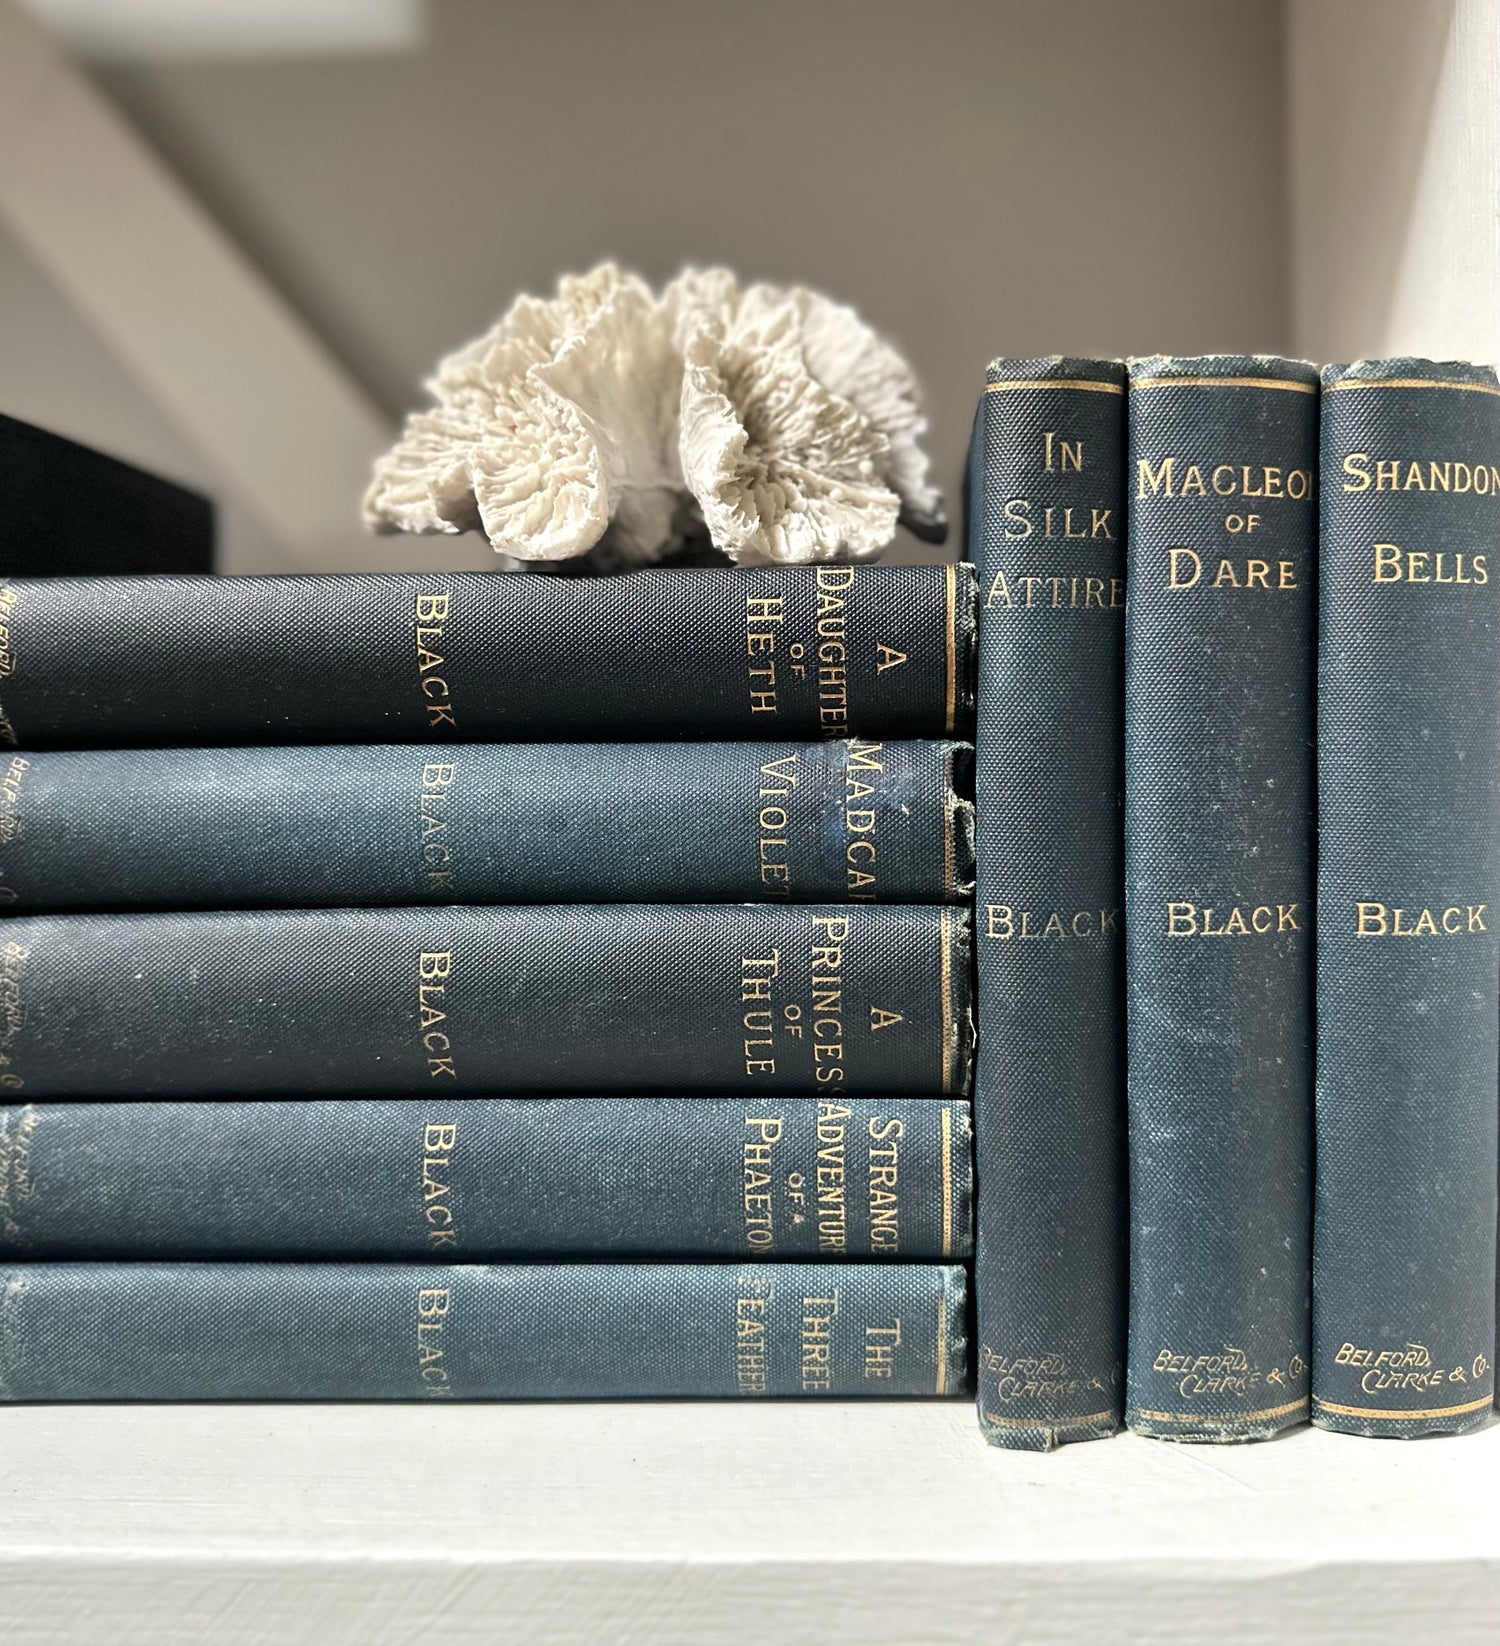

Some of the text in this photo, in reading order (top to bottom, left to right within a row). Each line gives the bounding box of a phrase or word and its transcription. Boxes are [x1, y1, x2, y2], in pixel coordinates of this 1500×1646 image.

[1043, 432, 1083, 472] IN
[1004, 499, 1117, 539] SILK
[1225, 513, 1261, 534] OF
[1169, 548, 1299, 590] DARE
[1373, 544, 1489, 585] BELLS
[984, 570, 1125, 609] ATTIRE
[416, 592, 456, 730] BLACK
[747, 596, 783, 715] HETH
[790, 643, 806, 680] OF
[816, 566, 854, 737] DAUGHTER
[877, 642, 907, 675] A
[421, 763, 455, 891] BLACK
[985, 903, 1119, 939] BLACK
[1167, 901, 1300, 937] BLACK
[1356, 901, 1488, 937] BLACK
[418, 950, 456, 1078] BLACK
[741, 948, 779, 1075] THULE
[784, 1004, 802, 1038] OF
[870, 1006, 903, 1031] A
[422, 1122, 457, 1251] BLACK
[789, 1172, 805, 1205] OF
[868, 1116, 904, 1252] STRANGE
[418, 1287, 454, 1399] BLACK
[802, 1288, 839, 1390] THREE
[865, 1318, 900, 1379] THE
[1179, 1369, 1260, 1398] CLARKE
[1266, 1366, 1286, 1388] &
[1361, 1367, 1446, 1395] CLARKE
[1448, 1366, 1468, 1384] &
